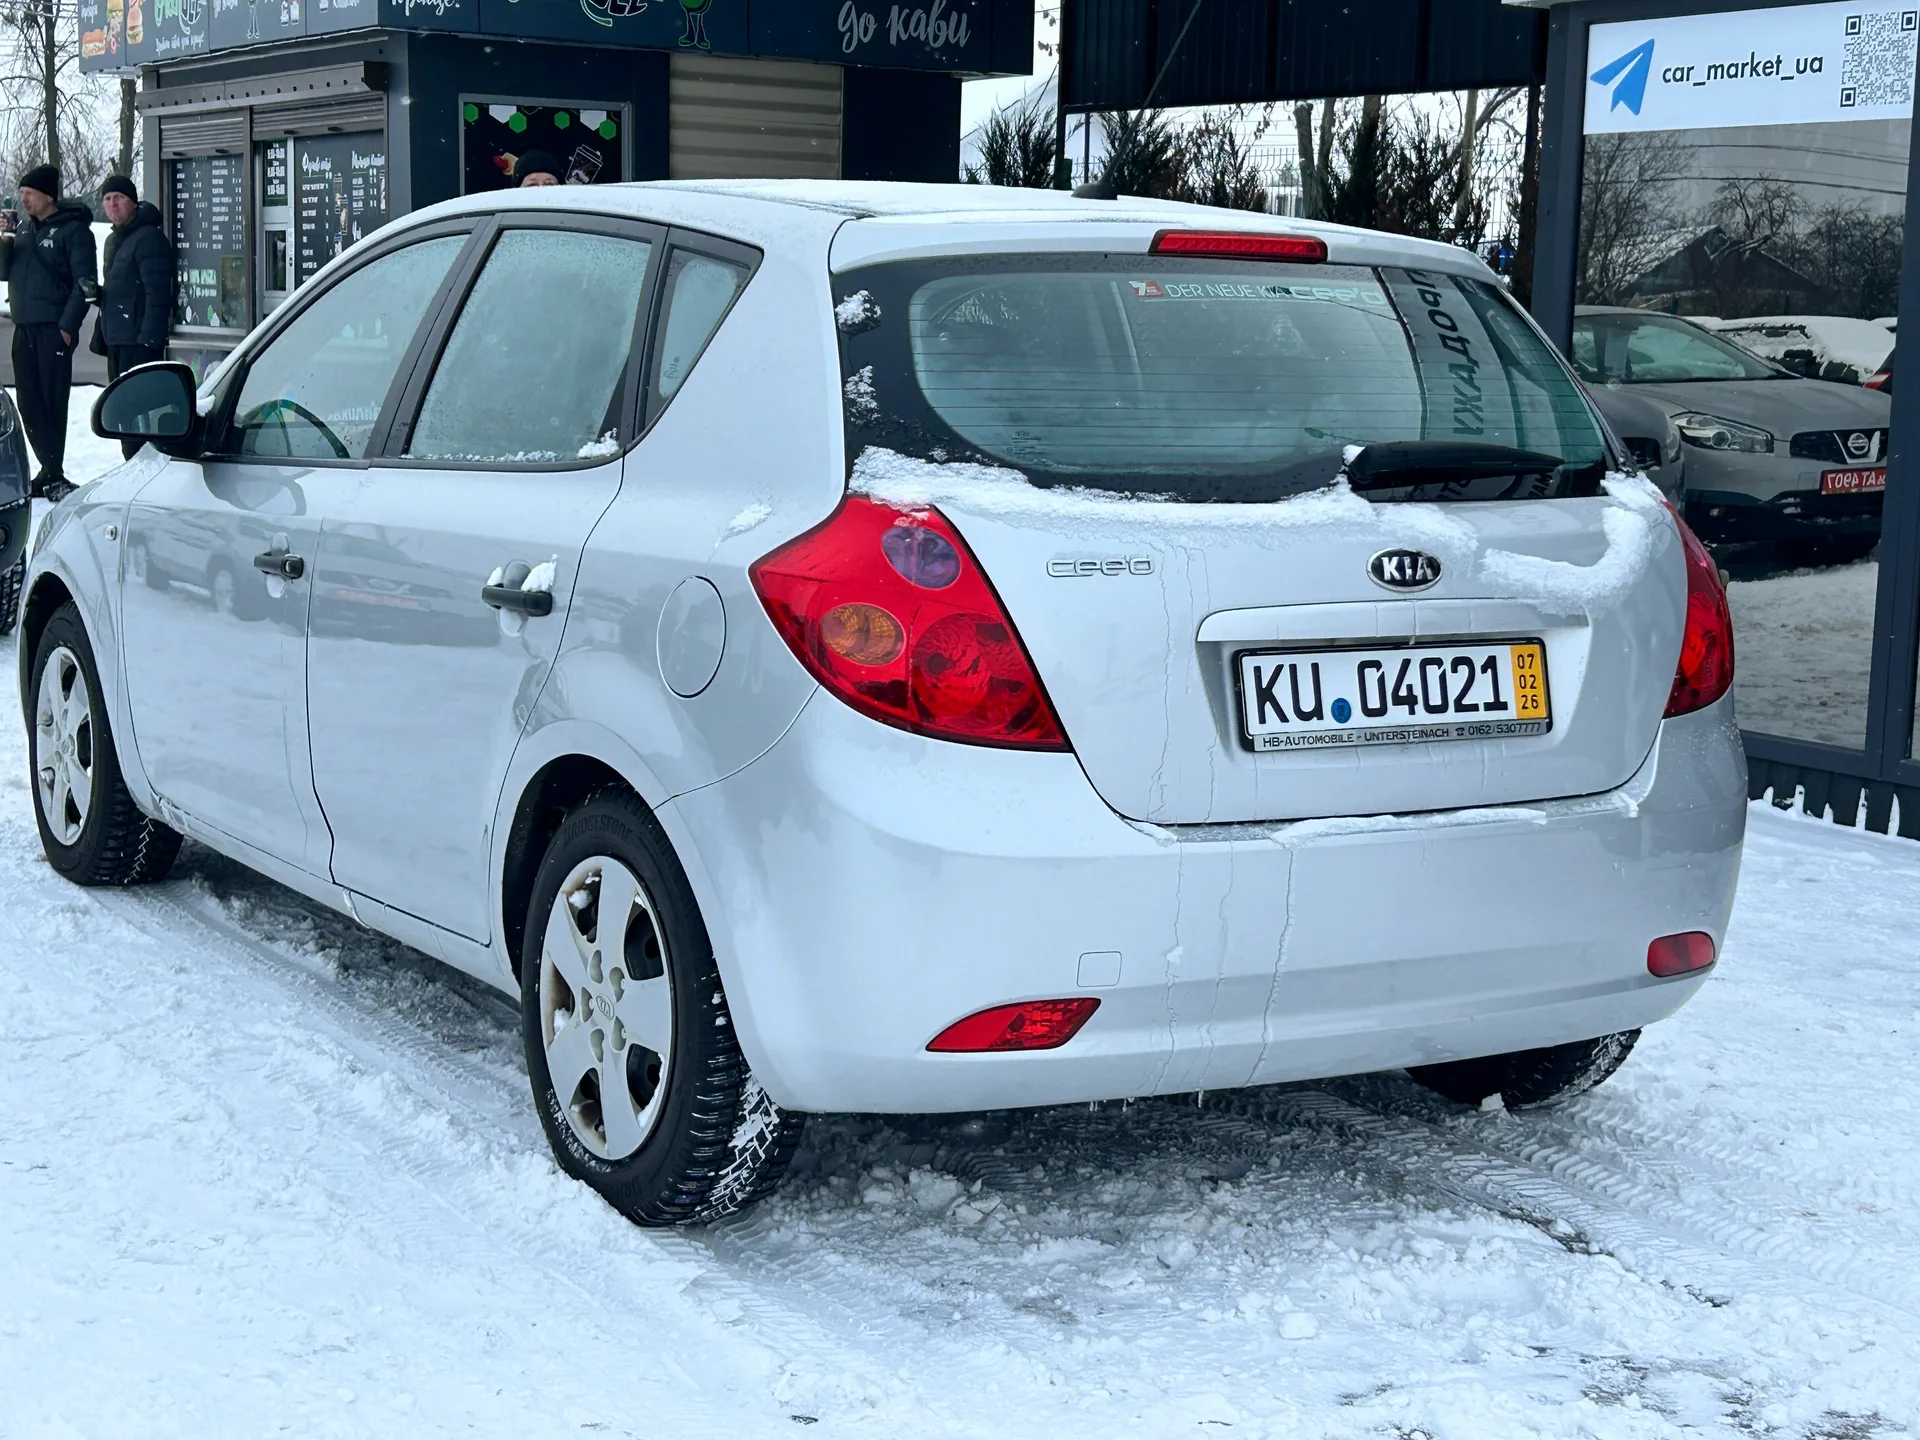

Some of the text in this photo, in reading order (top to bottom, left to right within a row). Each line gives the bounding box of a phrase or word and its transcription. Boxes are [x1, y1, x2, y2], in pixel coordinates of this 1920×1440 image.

[886, 0, 972, 48] кави
[1662, 51, 1823, 86] car_market_ua
[1165, 284, 1204, 298] DER
[1206, 284, 1257, 298] NEUE
[1380, 556, 1434, 580] KIA
[1517, 653, 1535, 669] 07
[1253, 655, 1509, 725] KU 04021
[1519, 674, 1537, 690] 02
[1520, 694, 1539, 710] 26
[1262, 733, 1355, 747] HB-AUTOMOBILE
[1364, 728, 1449, 742] UNTERSTEINACH
